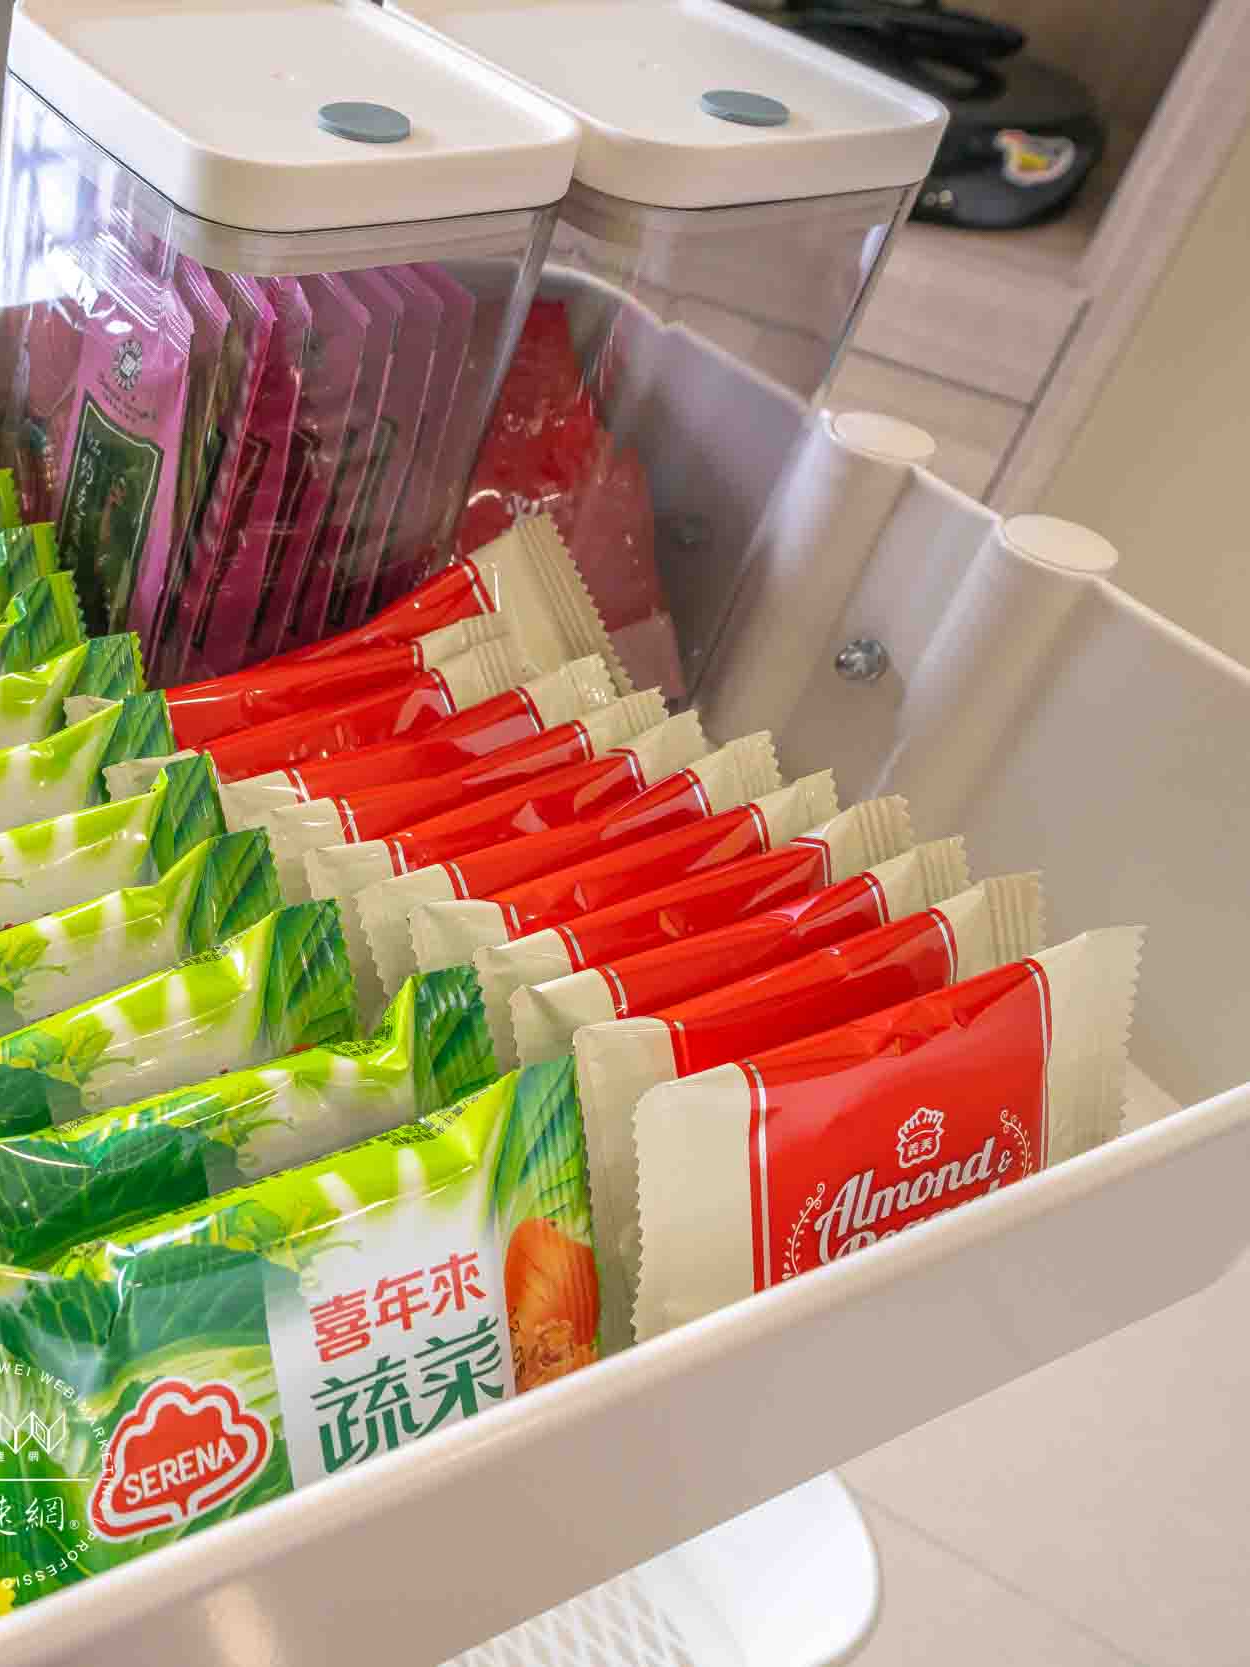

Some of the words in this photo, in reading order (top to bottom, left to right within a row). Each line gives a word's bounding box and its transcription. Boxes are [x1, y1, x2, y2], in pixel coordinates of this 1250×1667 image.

[814, 1136, 996, 1265] Almond
[997, 1150, 1013, 1173] &
[310, 1252, 487, 1362] 喜年來
[310, 1315, 504, 1473] 蔬菜
[123, 1437, 236, 1505] SERENA
